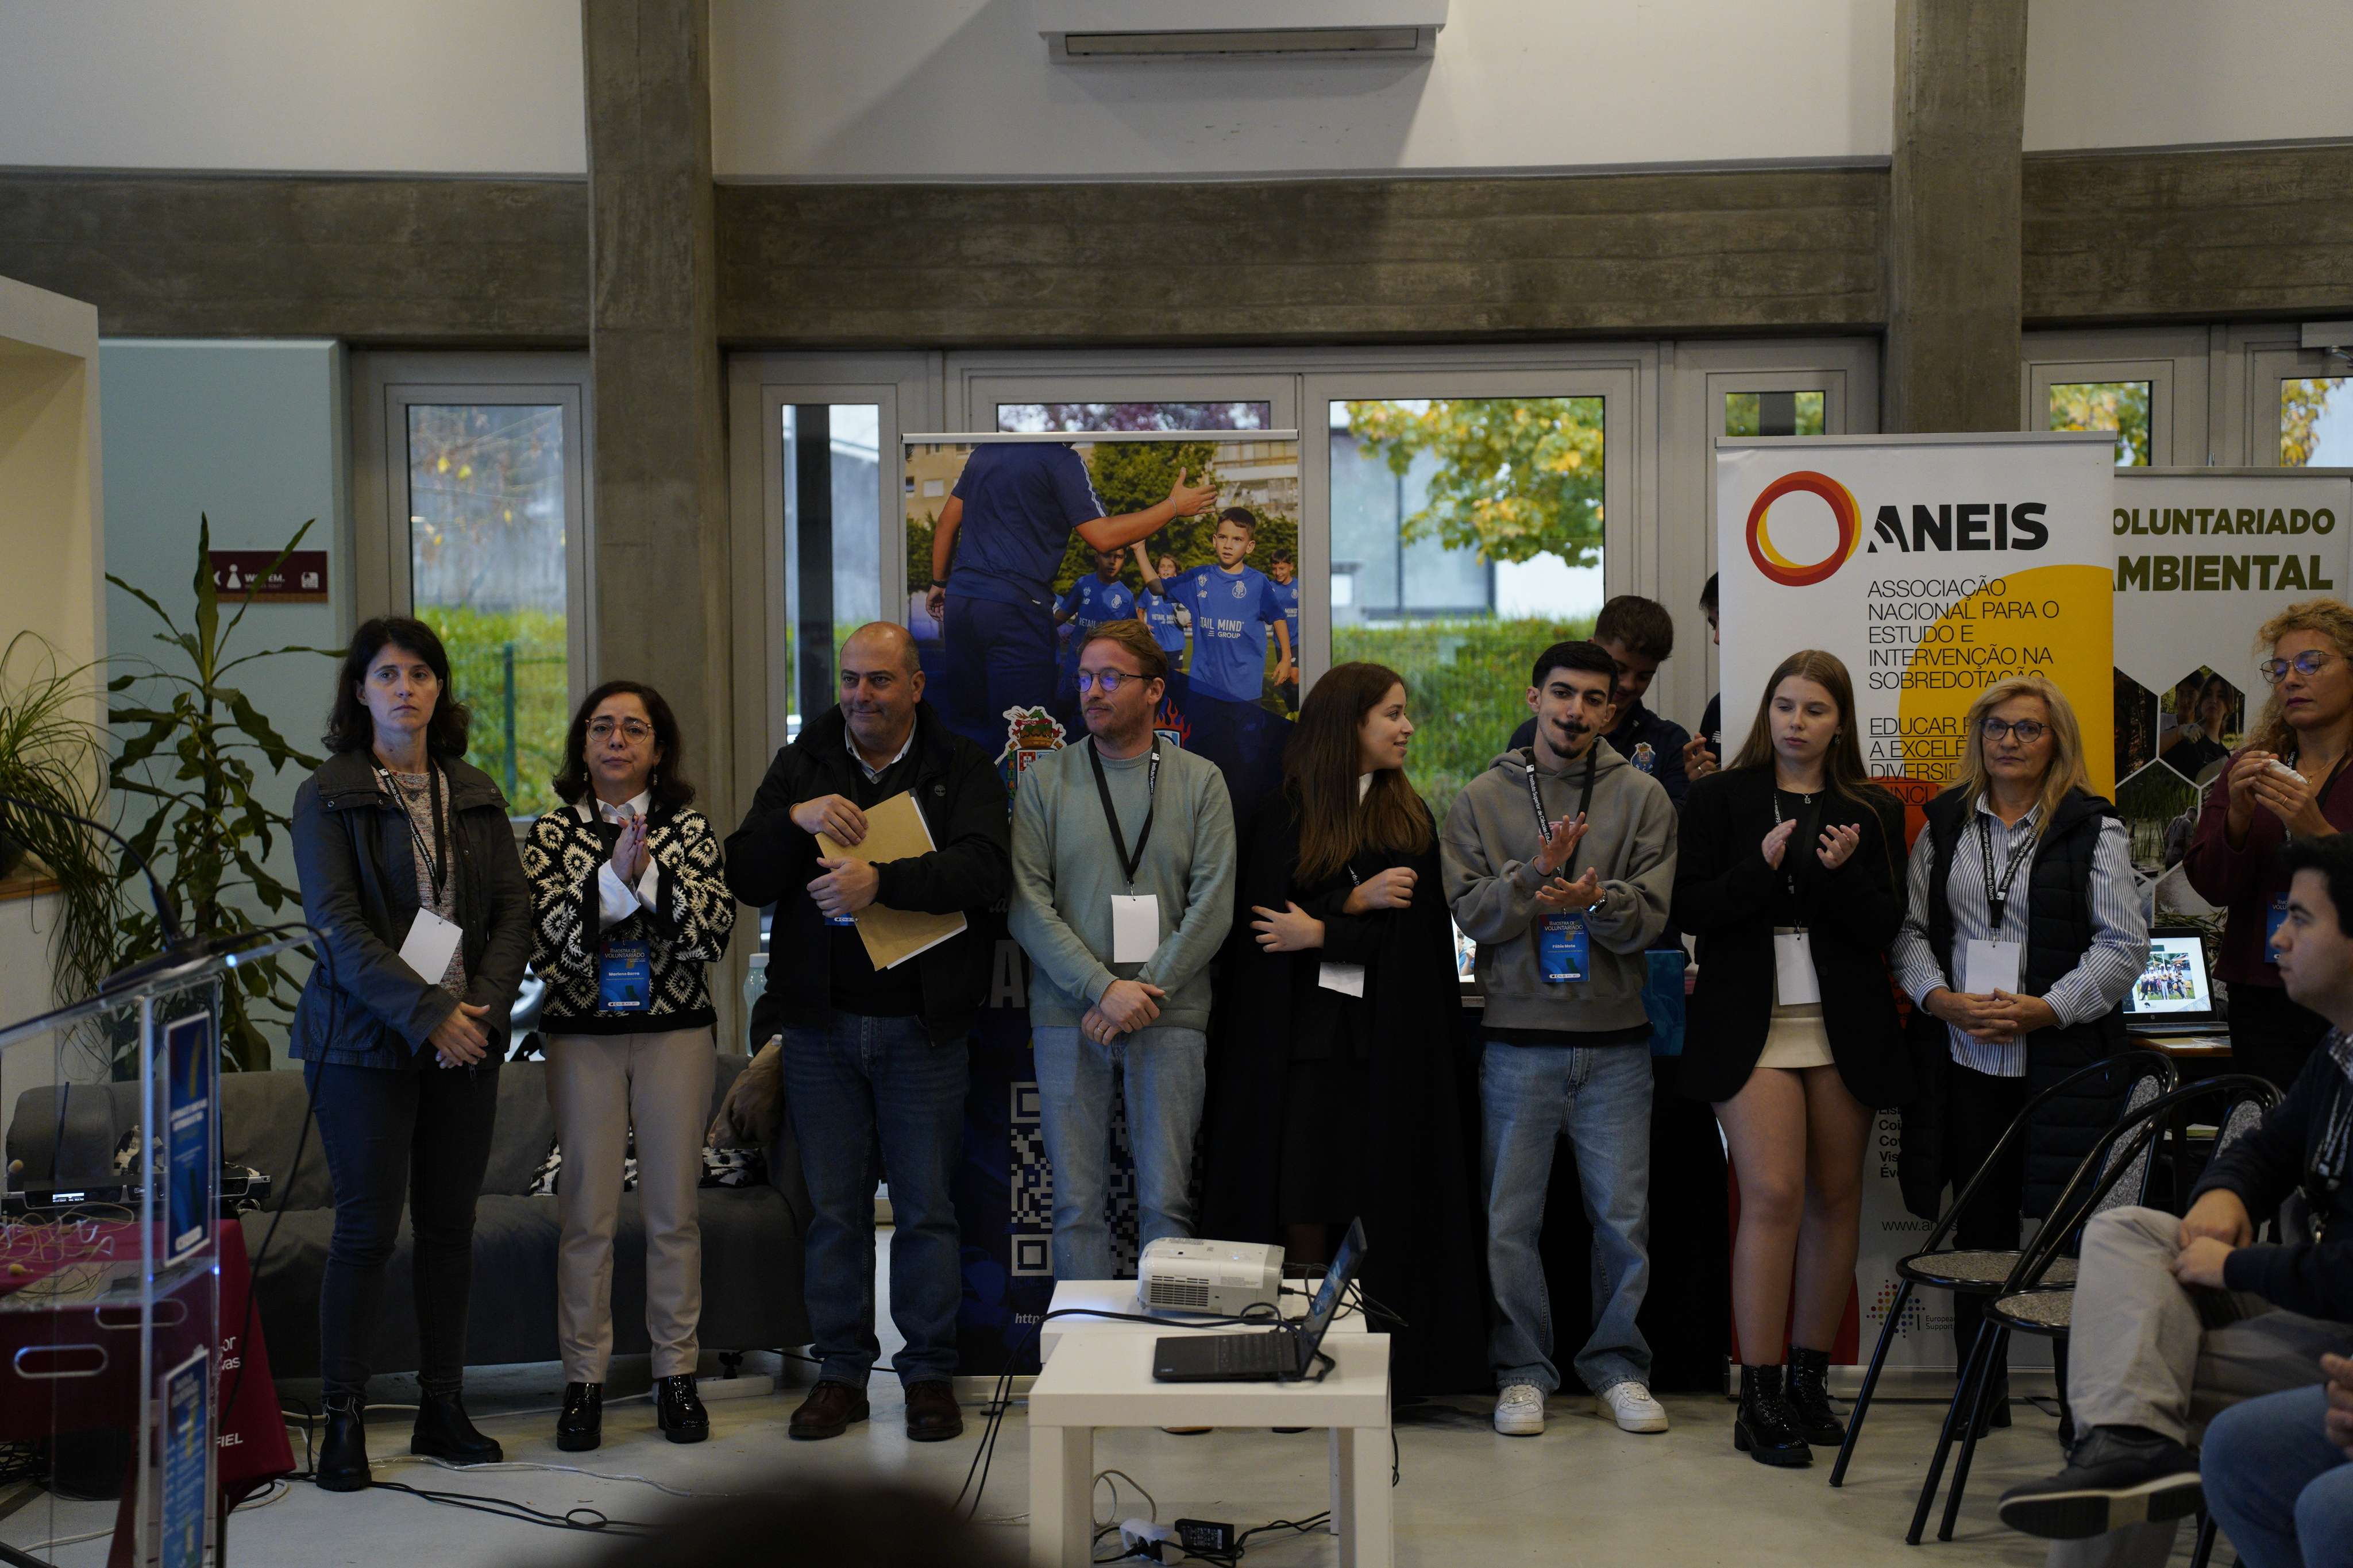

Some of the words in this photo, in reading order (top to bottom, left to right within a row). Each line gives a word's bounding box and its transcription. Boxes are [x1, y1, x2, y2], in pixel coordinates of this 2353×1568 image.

[1868, 502, 2049, 553] ANEIS
[2113, 555, 2333, 592] MBIENTAL
[1868, 575, 2006, 601] ASSOCIAÇÃO
[1869, 603, 1977, 621] NACIONAL
[1983, 601, 2036, 619] PARA
[2043, 601, 2059, 619] O
[1200, 617, 1214, 629] TAIL
[1869, 625, 1954, 644] ESTUDO
[1962, 625, 1974, 643] E
[1869, 643, 2017, 670] INTERVENÇÃO
[2023, 647, 2054, 665] NA
[1870, 717, 1957, 735] EDUCAR
[1870, 741, 1885, 758] A
[1533, 791, 1541, 810] Superior
[2008, 856, 2021, 873] Superior
[1881, 1164, 1899, 1177] Év
